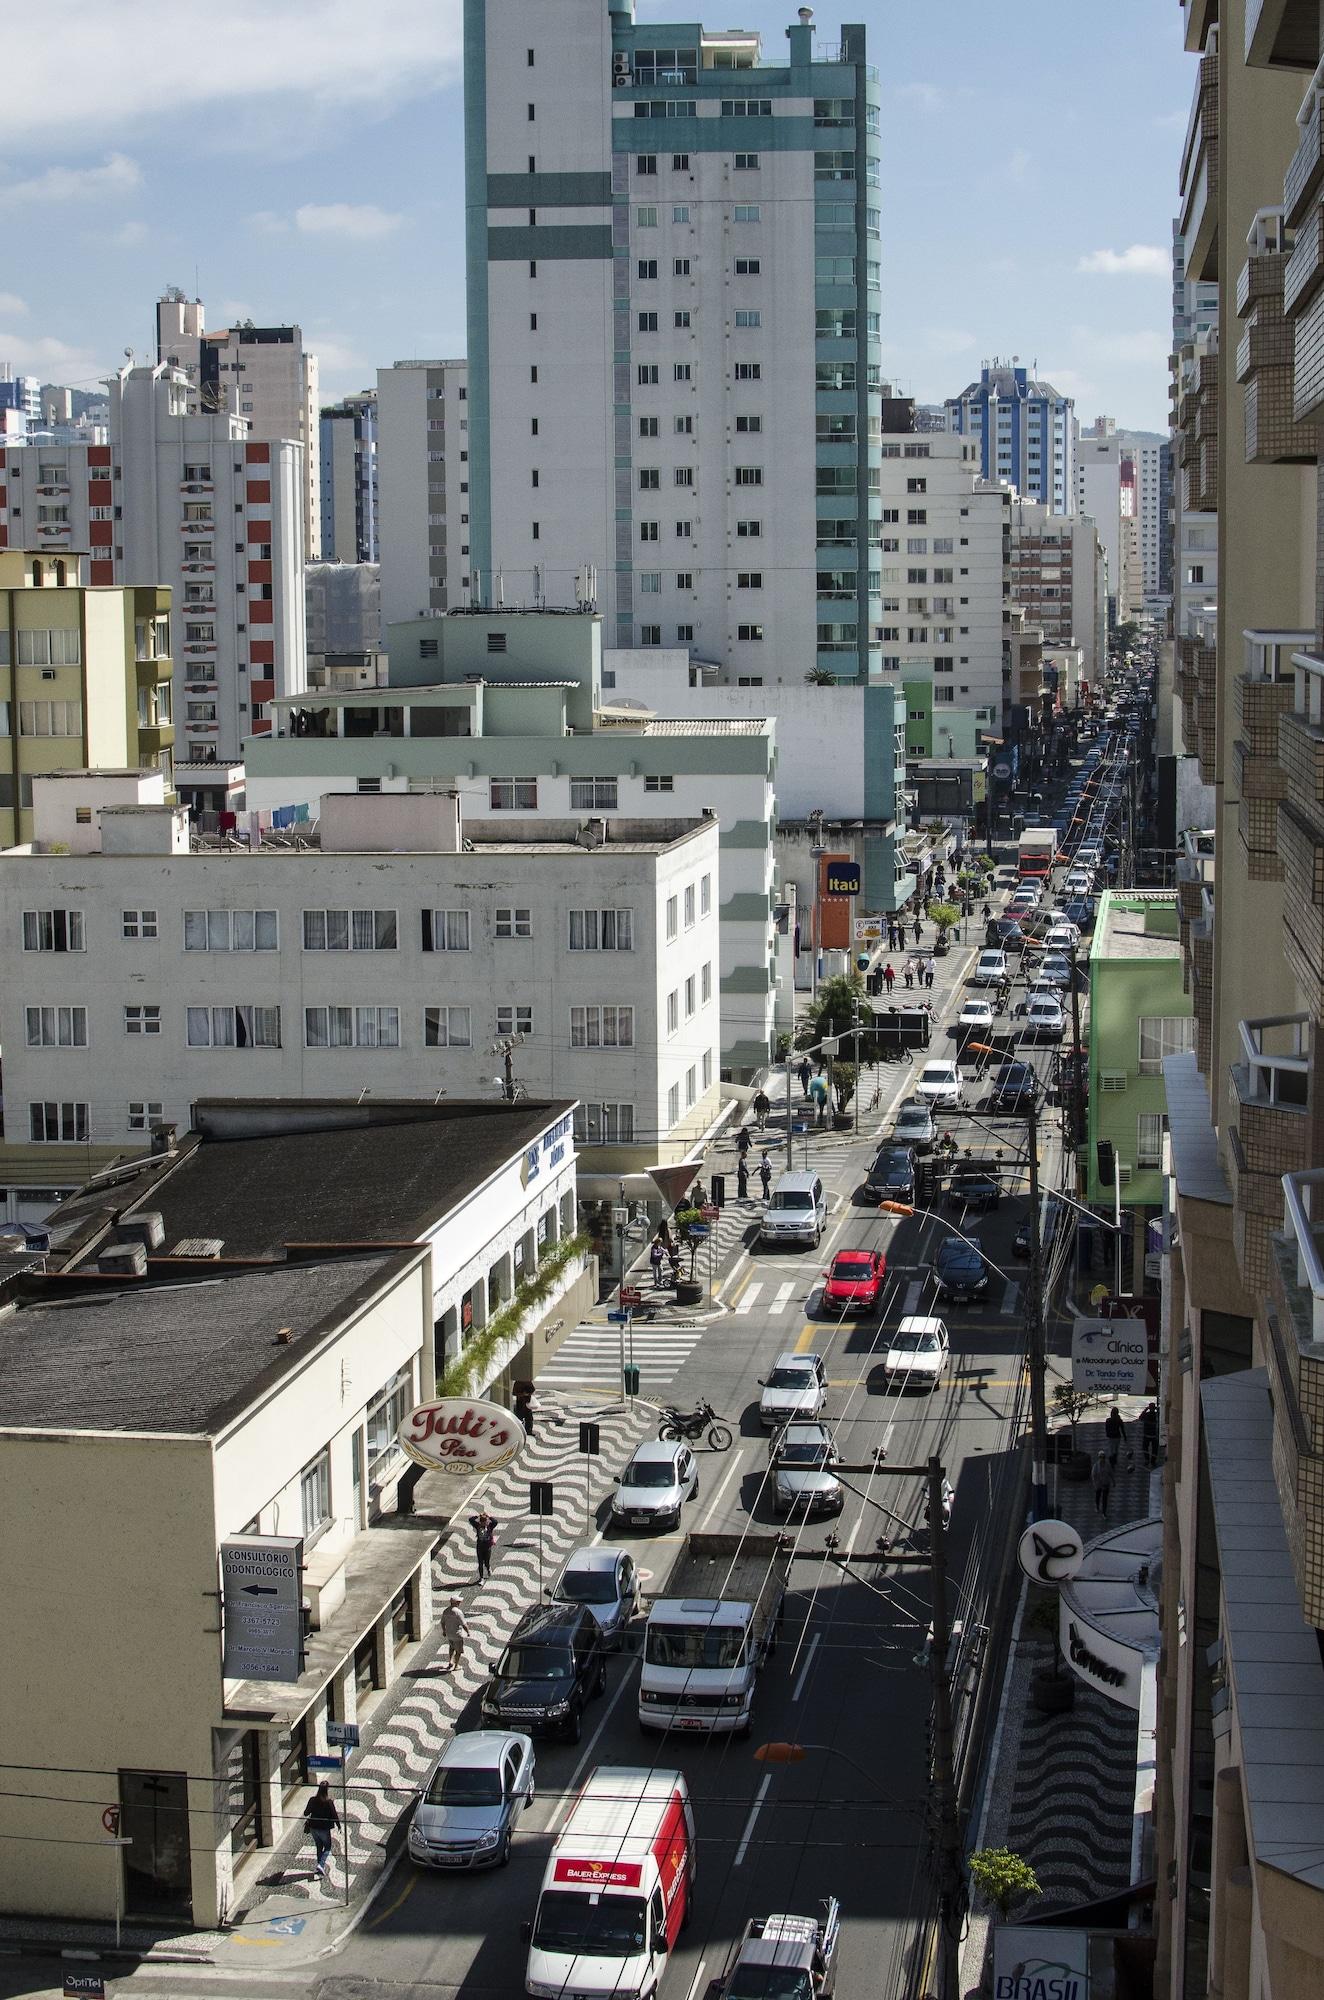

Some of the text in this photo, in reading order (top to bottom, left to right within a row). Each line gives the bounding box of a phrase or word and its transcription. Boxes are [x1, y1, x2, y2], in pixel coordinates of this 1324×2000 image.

[829, 878, 858, 891] Itaú
[1107, 1340, 1144, 1353] Clínica
[1085, 1369, 1095, 1377] Dr.
[449, 1463, 469, 1472] 1972
[228, 1550, 289, 1564] CONSULTÓRIO
[225, 1563, 294, 1578] ODONTOLÓGICO
[567, 1869, 592, 1879] BAUER
[66, 1976, 101, 1988] OptiTel
